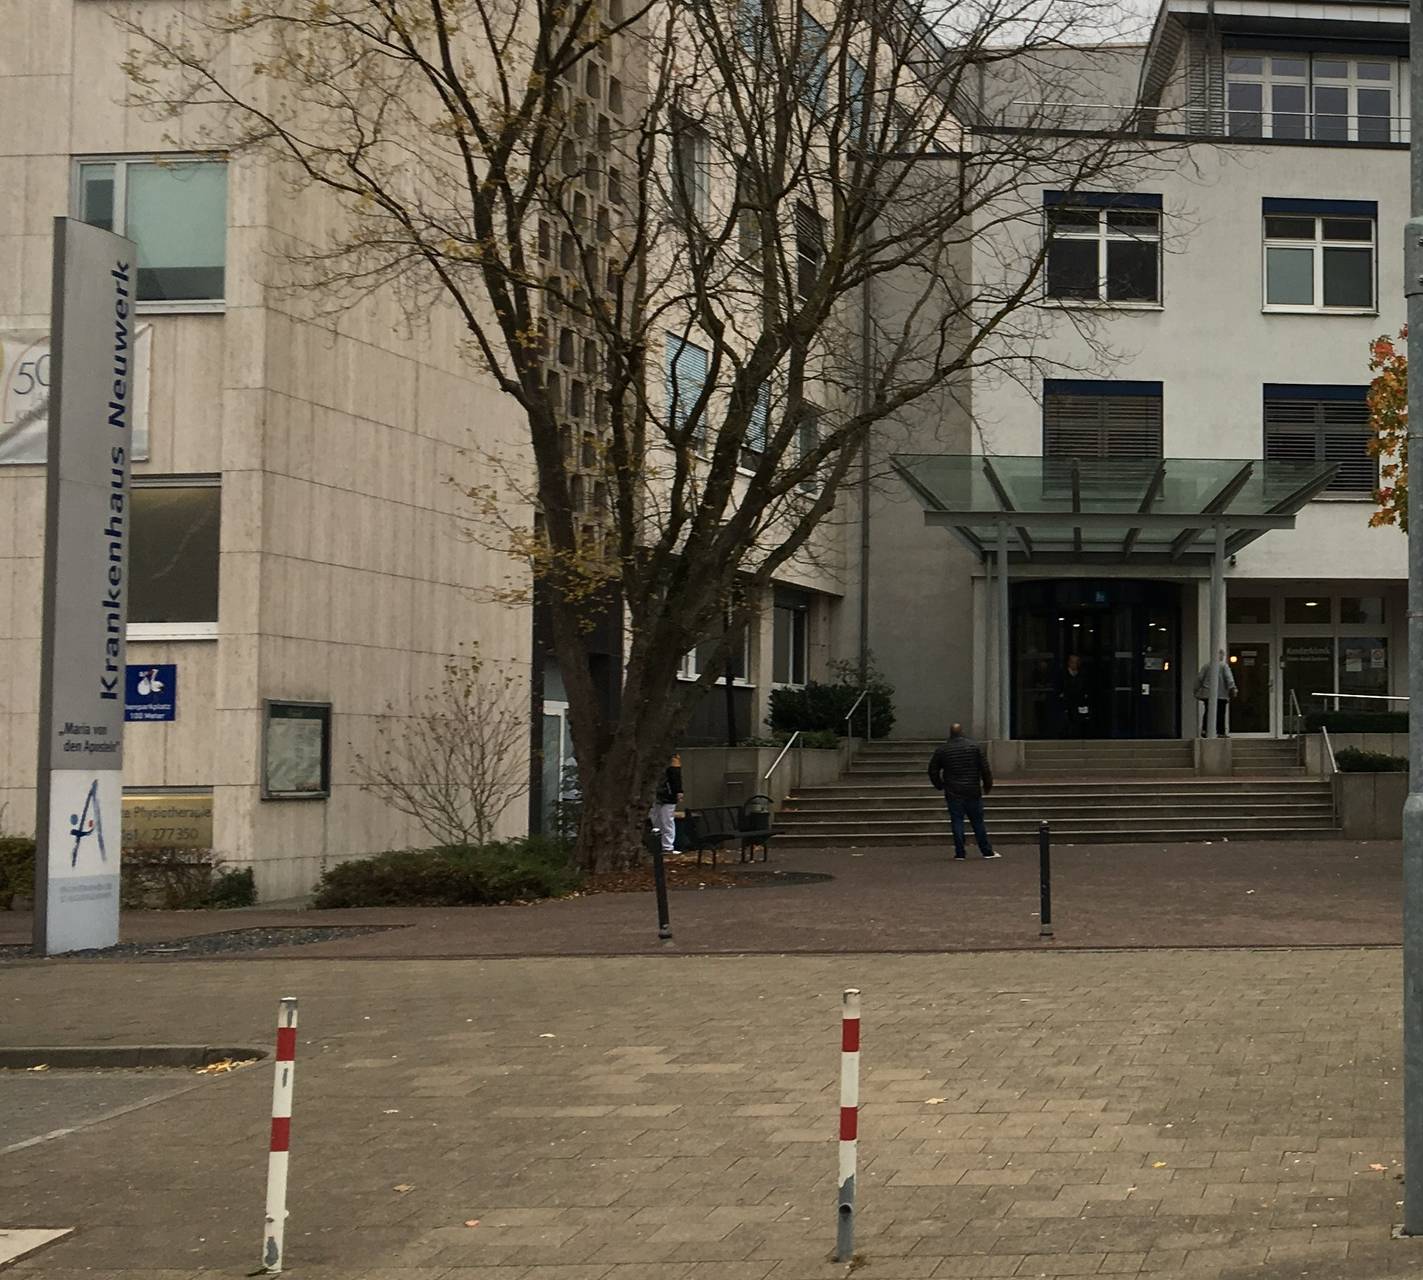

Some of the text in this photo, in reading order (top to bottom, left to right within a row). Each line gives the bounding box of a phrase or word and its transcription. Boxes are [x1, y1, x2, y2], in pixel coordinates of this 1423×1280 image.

[101, 259, 130, 700] Krankenhaus Neuwerk
[134, 805, 213, 820] Physiotherapie
